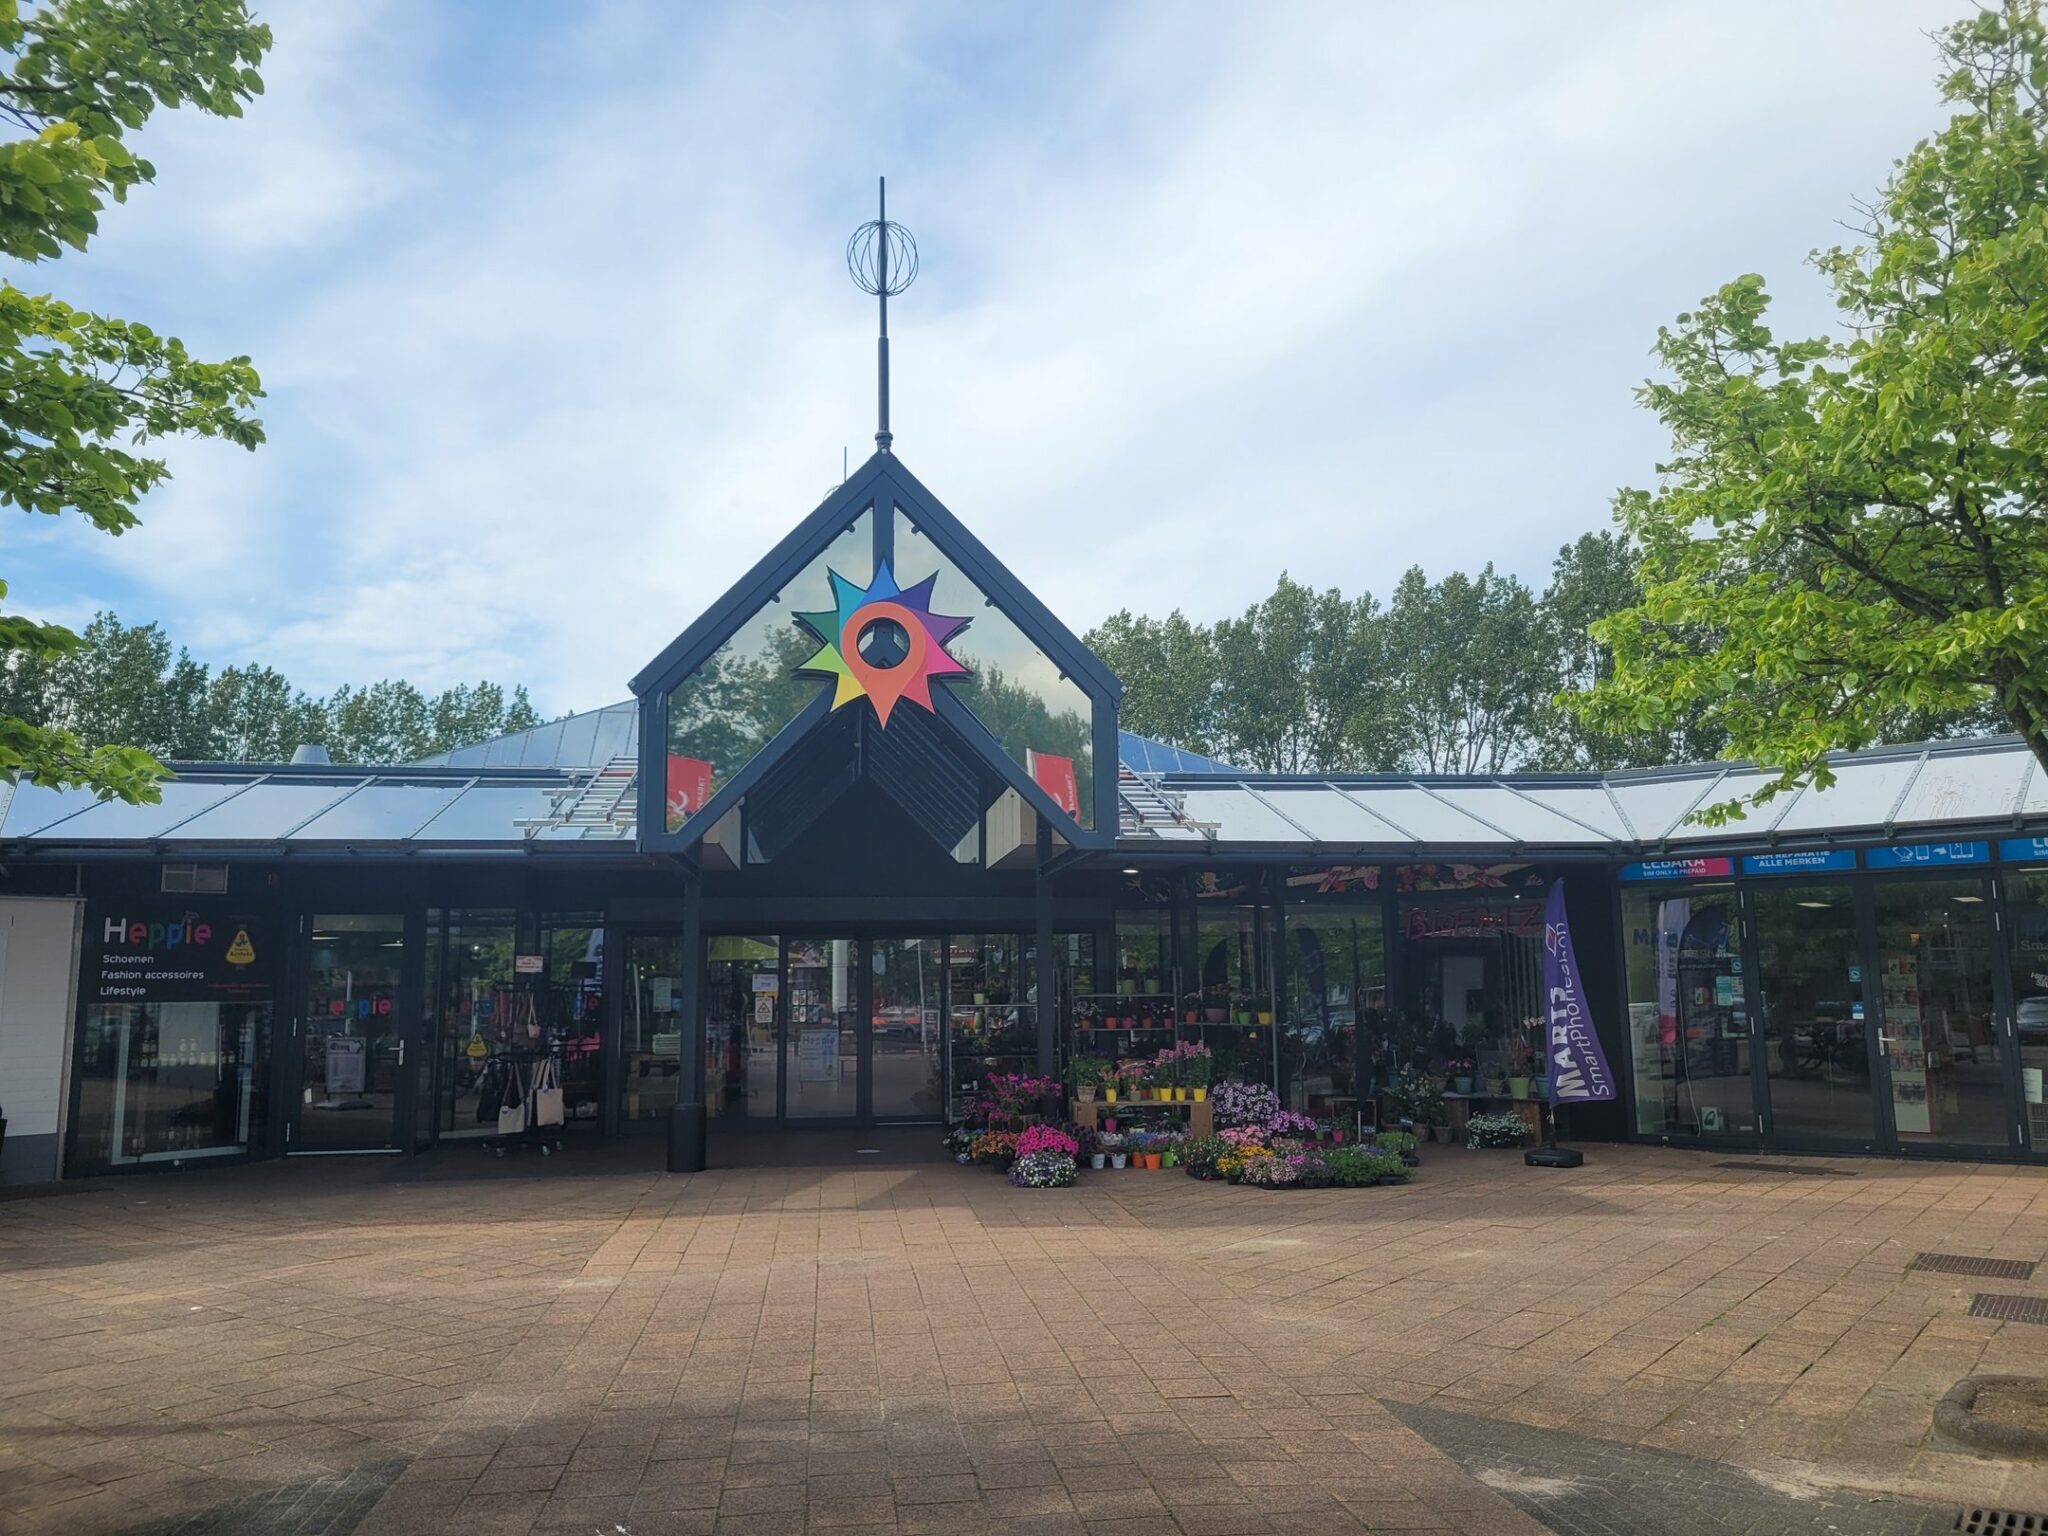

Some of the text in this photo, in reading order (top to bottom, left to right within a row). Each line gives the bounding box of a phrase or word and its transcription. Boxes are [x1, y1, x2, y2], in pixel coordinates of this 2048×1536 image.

[1758, 857, 1826, 867] ALLE MERKEN
[103, 917, 212, 949] Heppie
[103, 954, 154, 964] Schoenen
[101, 970, 205, 980] Fashion accessoires
[100, 986, 146, 997] Lifestyle
[1550, 987, 1590, 1098] MARTS
